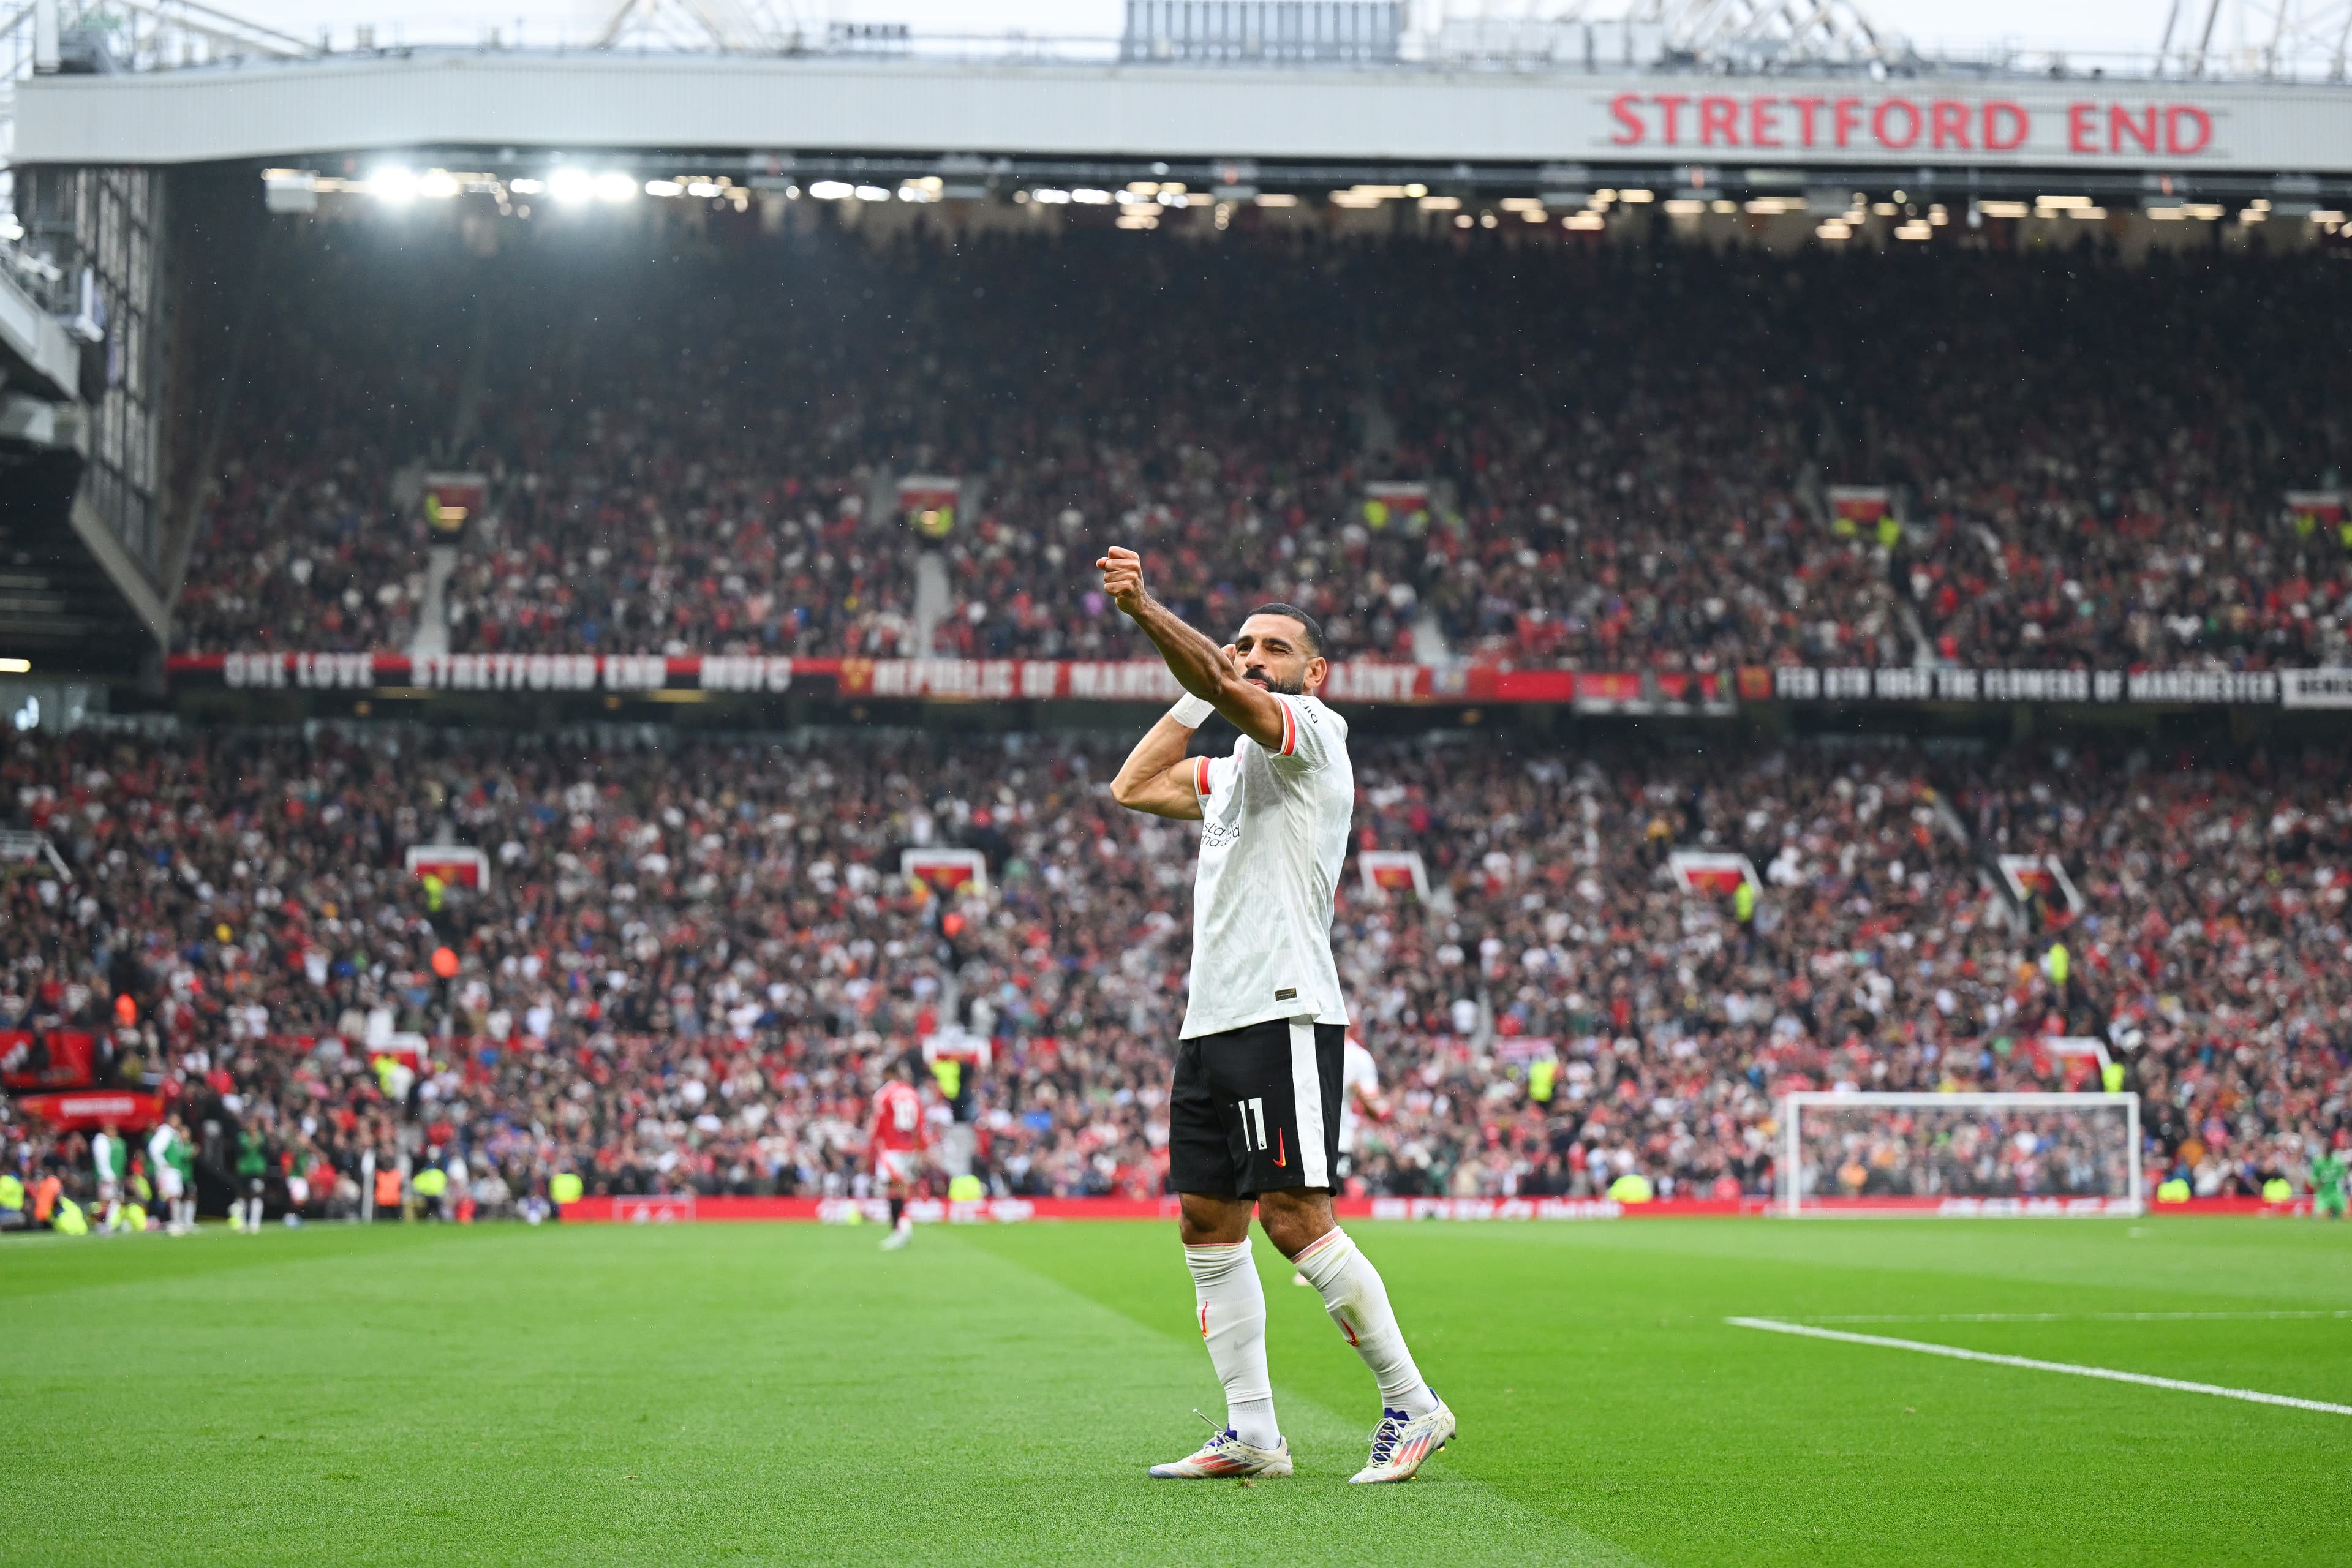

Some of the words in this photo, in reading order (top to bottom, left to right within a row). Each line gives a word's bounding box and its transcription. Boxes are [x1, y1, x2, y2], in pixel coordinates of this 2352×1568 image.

[1610, 94, 2030, 151] STRETFORD
[2068, 102, 2213, 155] END
[224, 652, 287, 688] ONE
[297, 652, 375, 688] LOVE
[412, 654, 596, 690] STRETFORD
[603, 654, 666, 691] END
[1022, 661, 1058, 698] OF
[2094, 669, 2121, 701] OF
[1238, 1097, 1267, 1152] 11
[1408, 1420, 1438, 1439] F50
